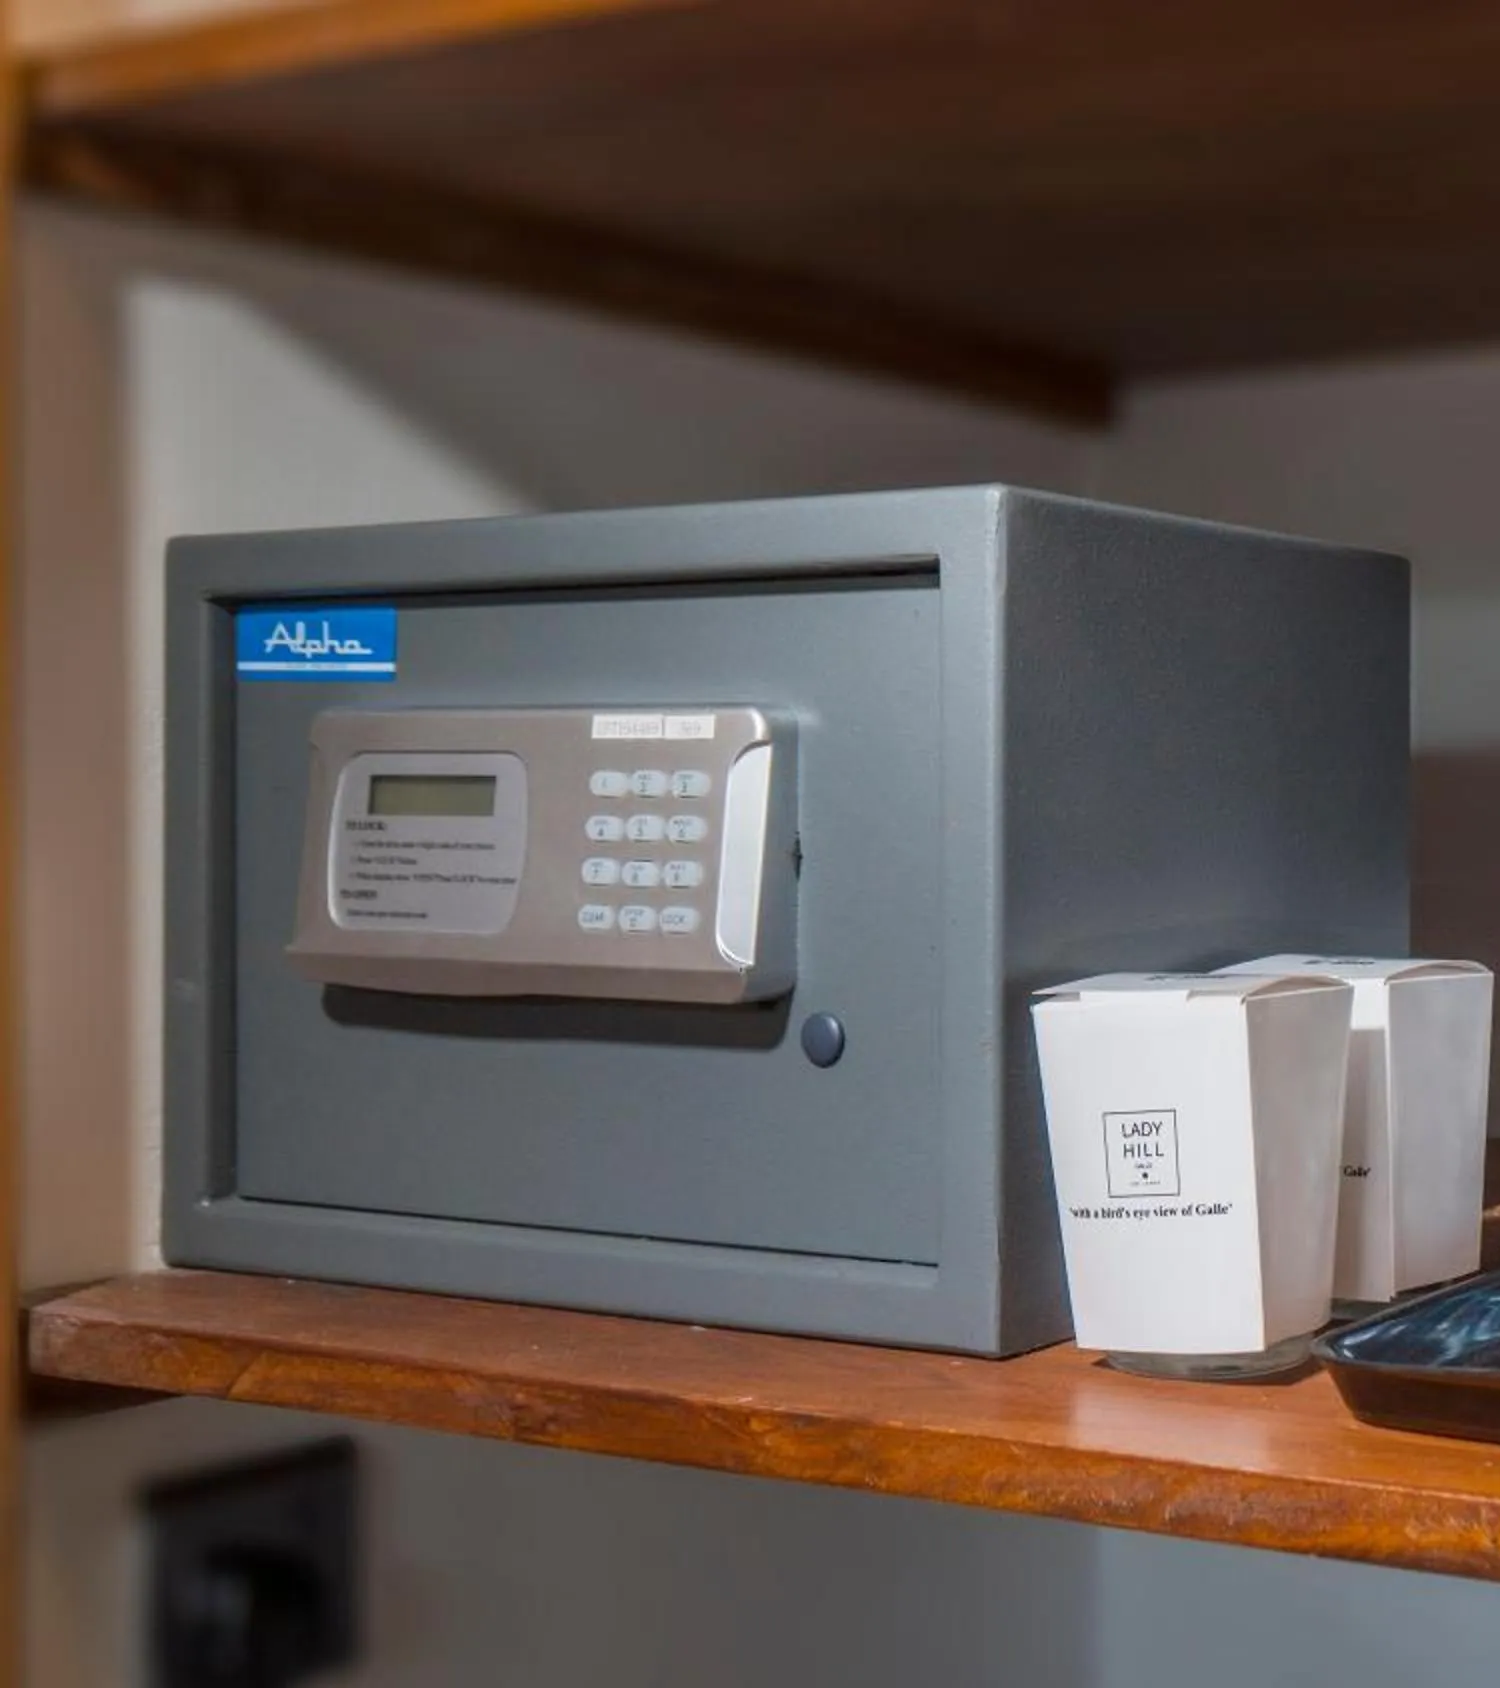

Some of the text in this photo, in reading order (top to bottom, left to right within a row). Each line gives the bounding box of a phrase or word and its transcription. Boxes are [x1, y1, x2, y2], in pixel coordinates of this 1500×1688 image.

[264, 621, 373, 658] Alpha
[1121, 1121, 1163, 1138] LADY
[1123, 1142, 1165, 1158] HILL
[1153, 1205, 1178, 1217] view
[1181, 1203, 1193, 1216] of
